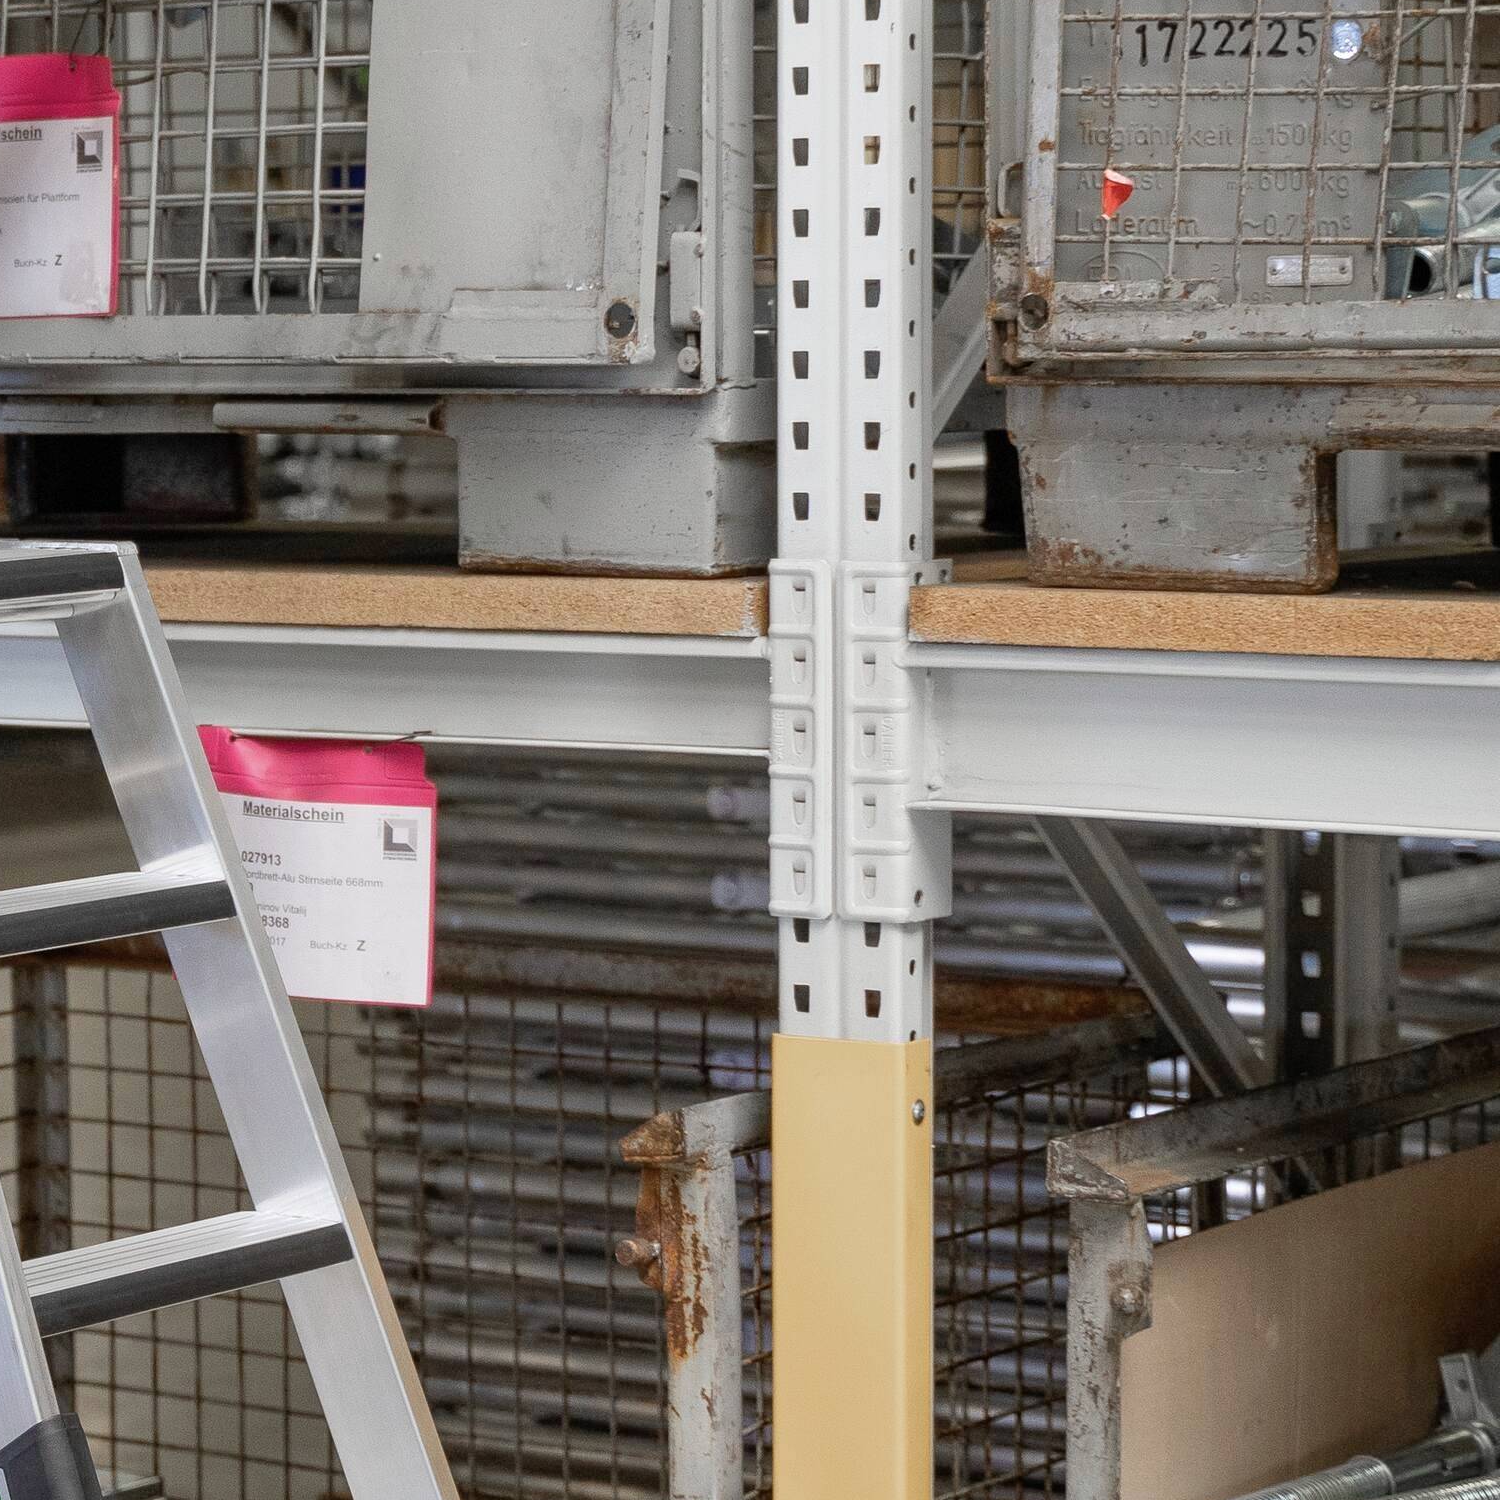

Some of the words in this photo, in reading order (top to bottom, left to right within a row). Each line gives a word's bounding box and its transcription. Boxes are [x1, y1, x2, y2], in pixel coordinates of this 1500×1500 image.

[54, 254, 63, 267] Z
[243, 800, 345, 824] Materialschein
[242, 850, 282, 867] 027913
[245, 869, 296, 884] ordbrett-Alu
[345, 876, 384, 888] 668mm
[261, 914, 290, 929] 8368
[356, 940, 366, 952] Z
